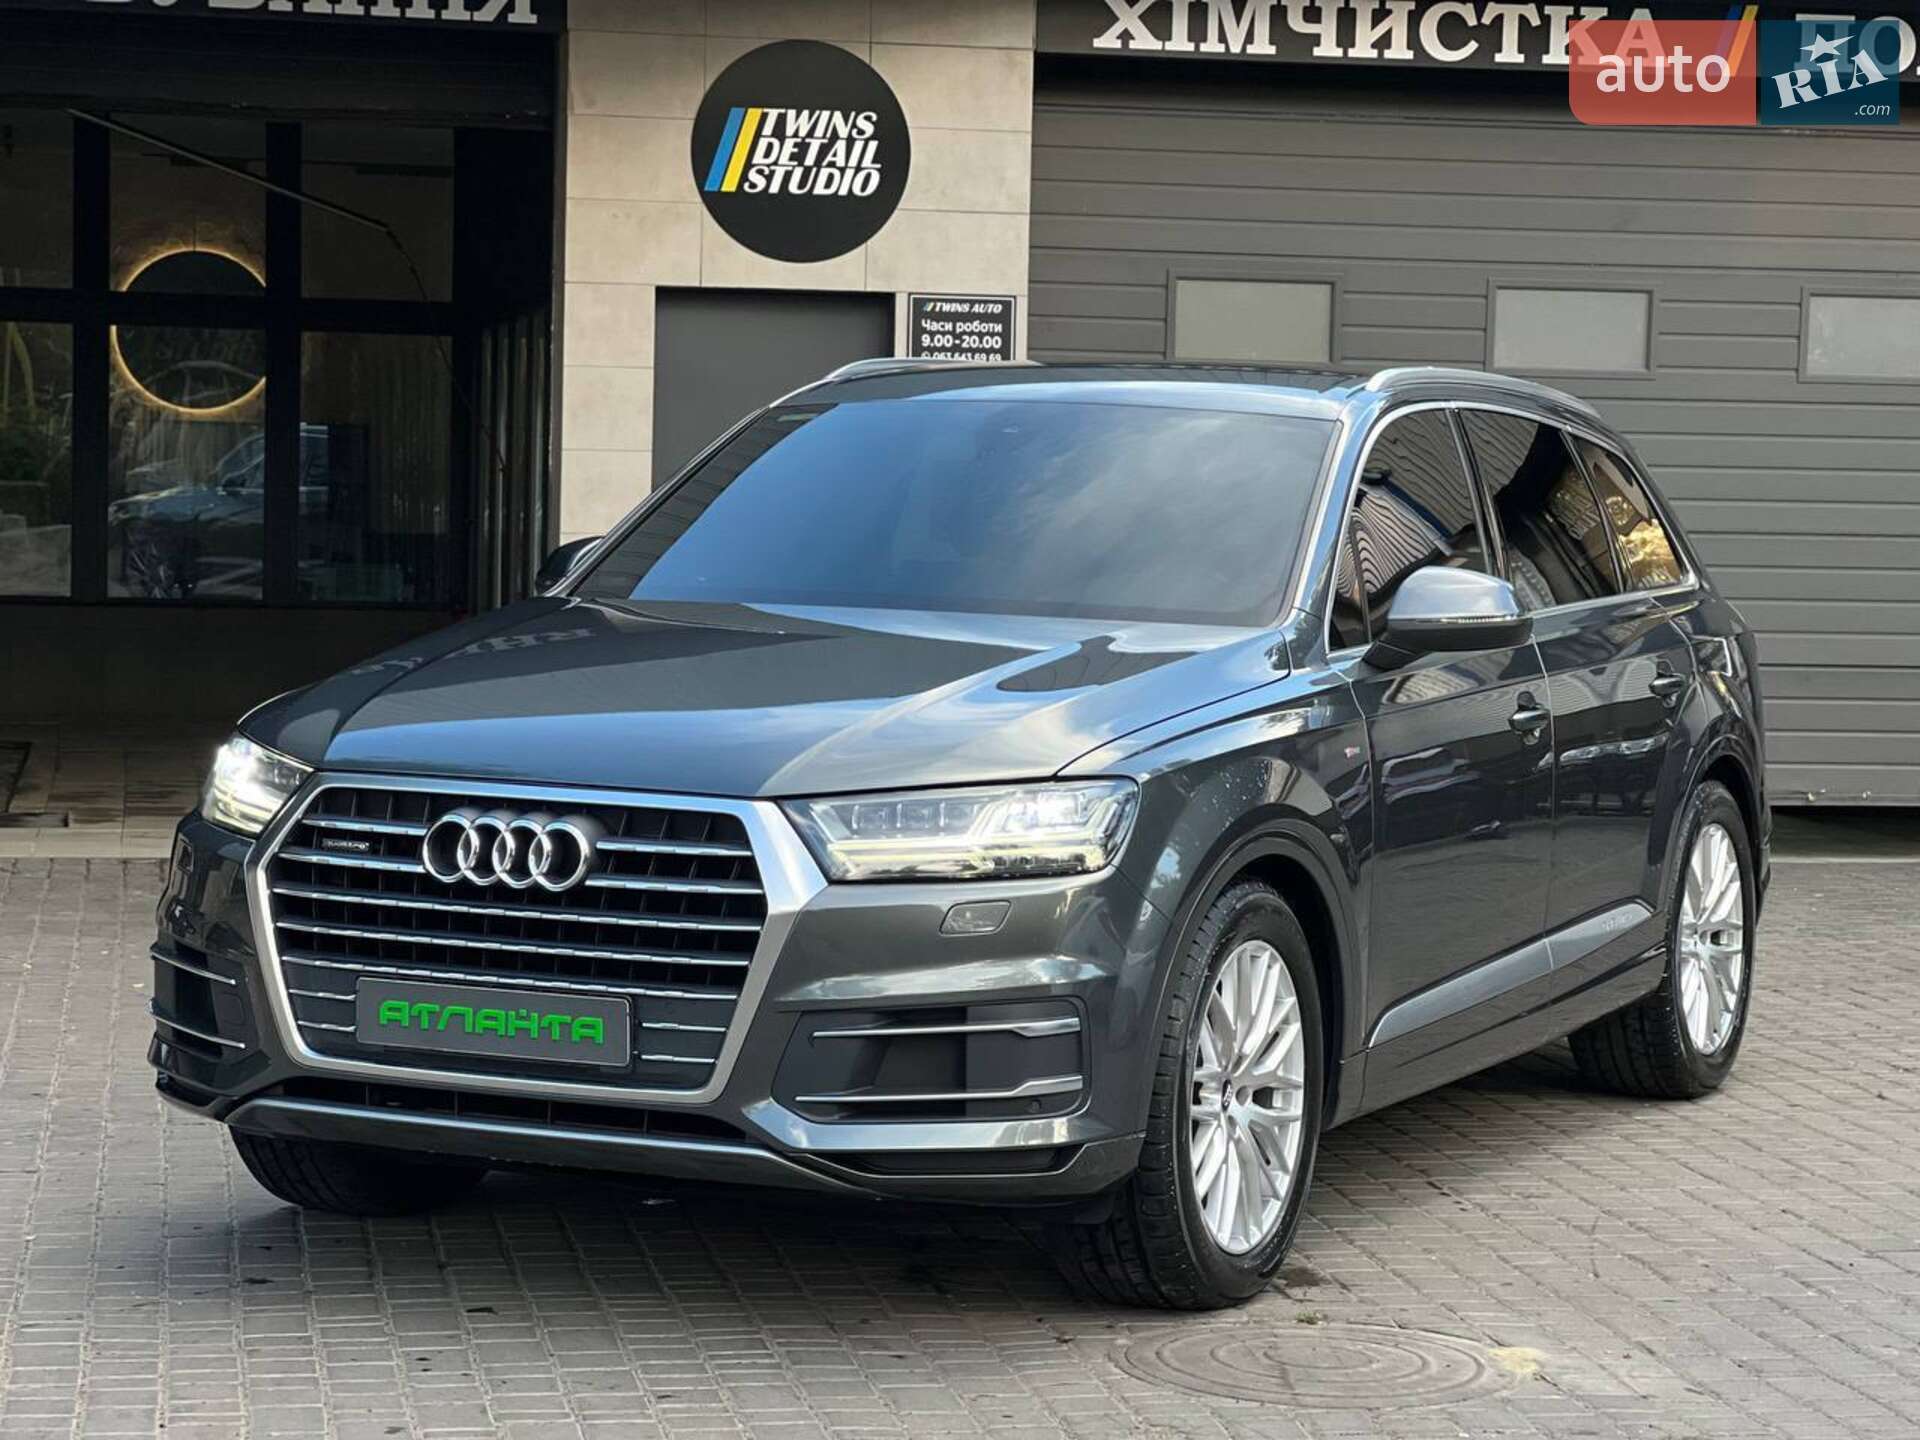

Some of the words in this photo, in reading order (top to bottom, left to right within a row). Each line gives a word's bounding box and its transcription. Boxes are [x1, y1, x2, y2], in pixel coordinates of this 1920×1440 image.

[1093, 0, 1670, 68] ХІМЧИСТКА
[1793, 13, 1920, 76] ПО
[760, 107, 878, 139] TWINS
[751, 137, 882, 169] DETAIL
[743, 165, 881, 197] STUDIO
[935, 302, 971, 313] TWINS
[971, 304, 1003, 314] AUTO
[921, 318, 953, 331] Часи
[956, 320, 1003, 333] роботи
